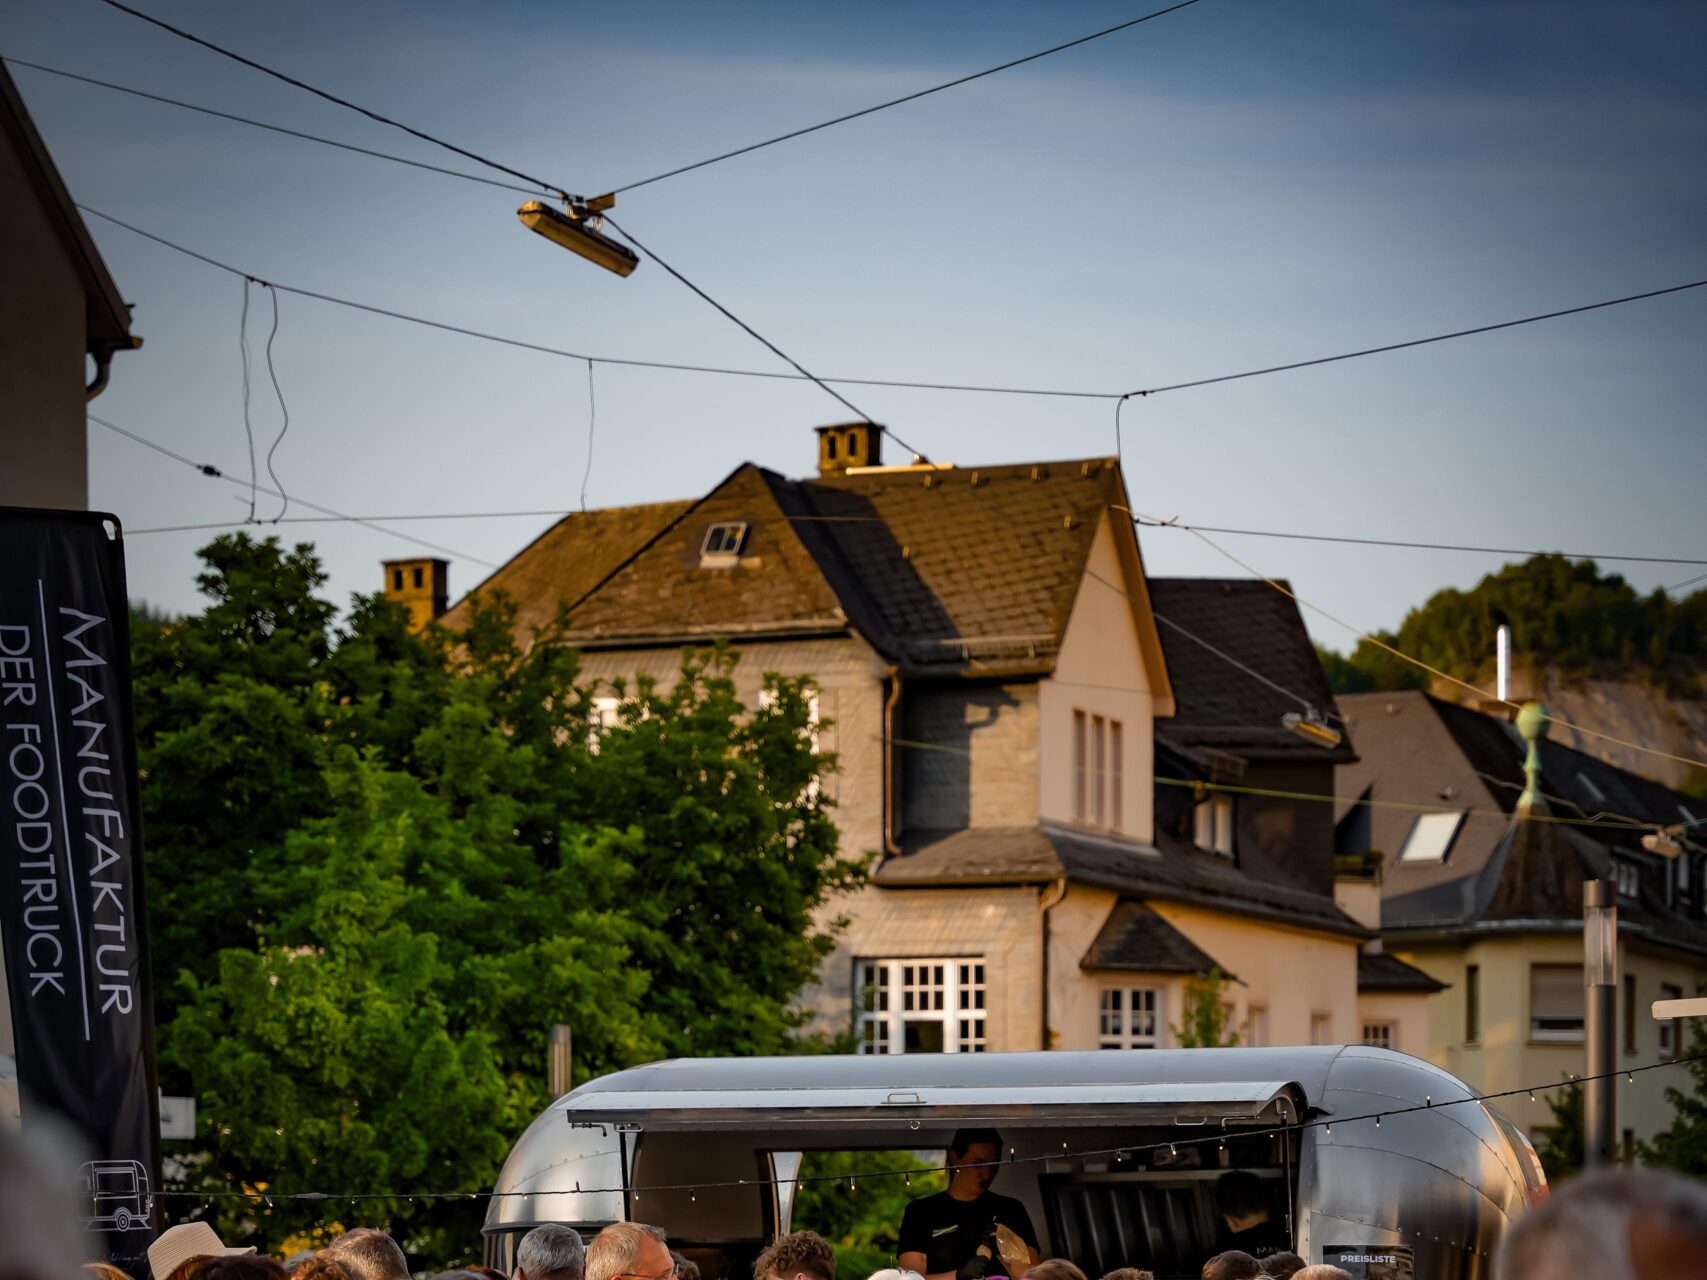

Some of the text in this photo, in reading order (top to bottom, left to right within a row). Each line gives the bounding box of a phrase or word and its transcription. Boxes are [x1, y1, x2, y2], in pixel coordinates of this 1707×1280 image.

[0, 625, 66, 998] DER FOODTRUCK
[58, 606, 133, 1015] MANUFAKTUR
[1340, 1254, 1396, 1263] PREISLISTE
